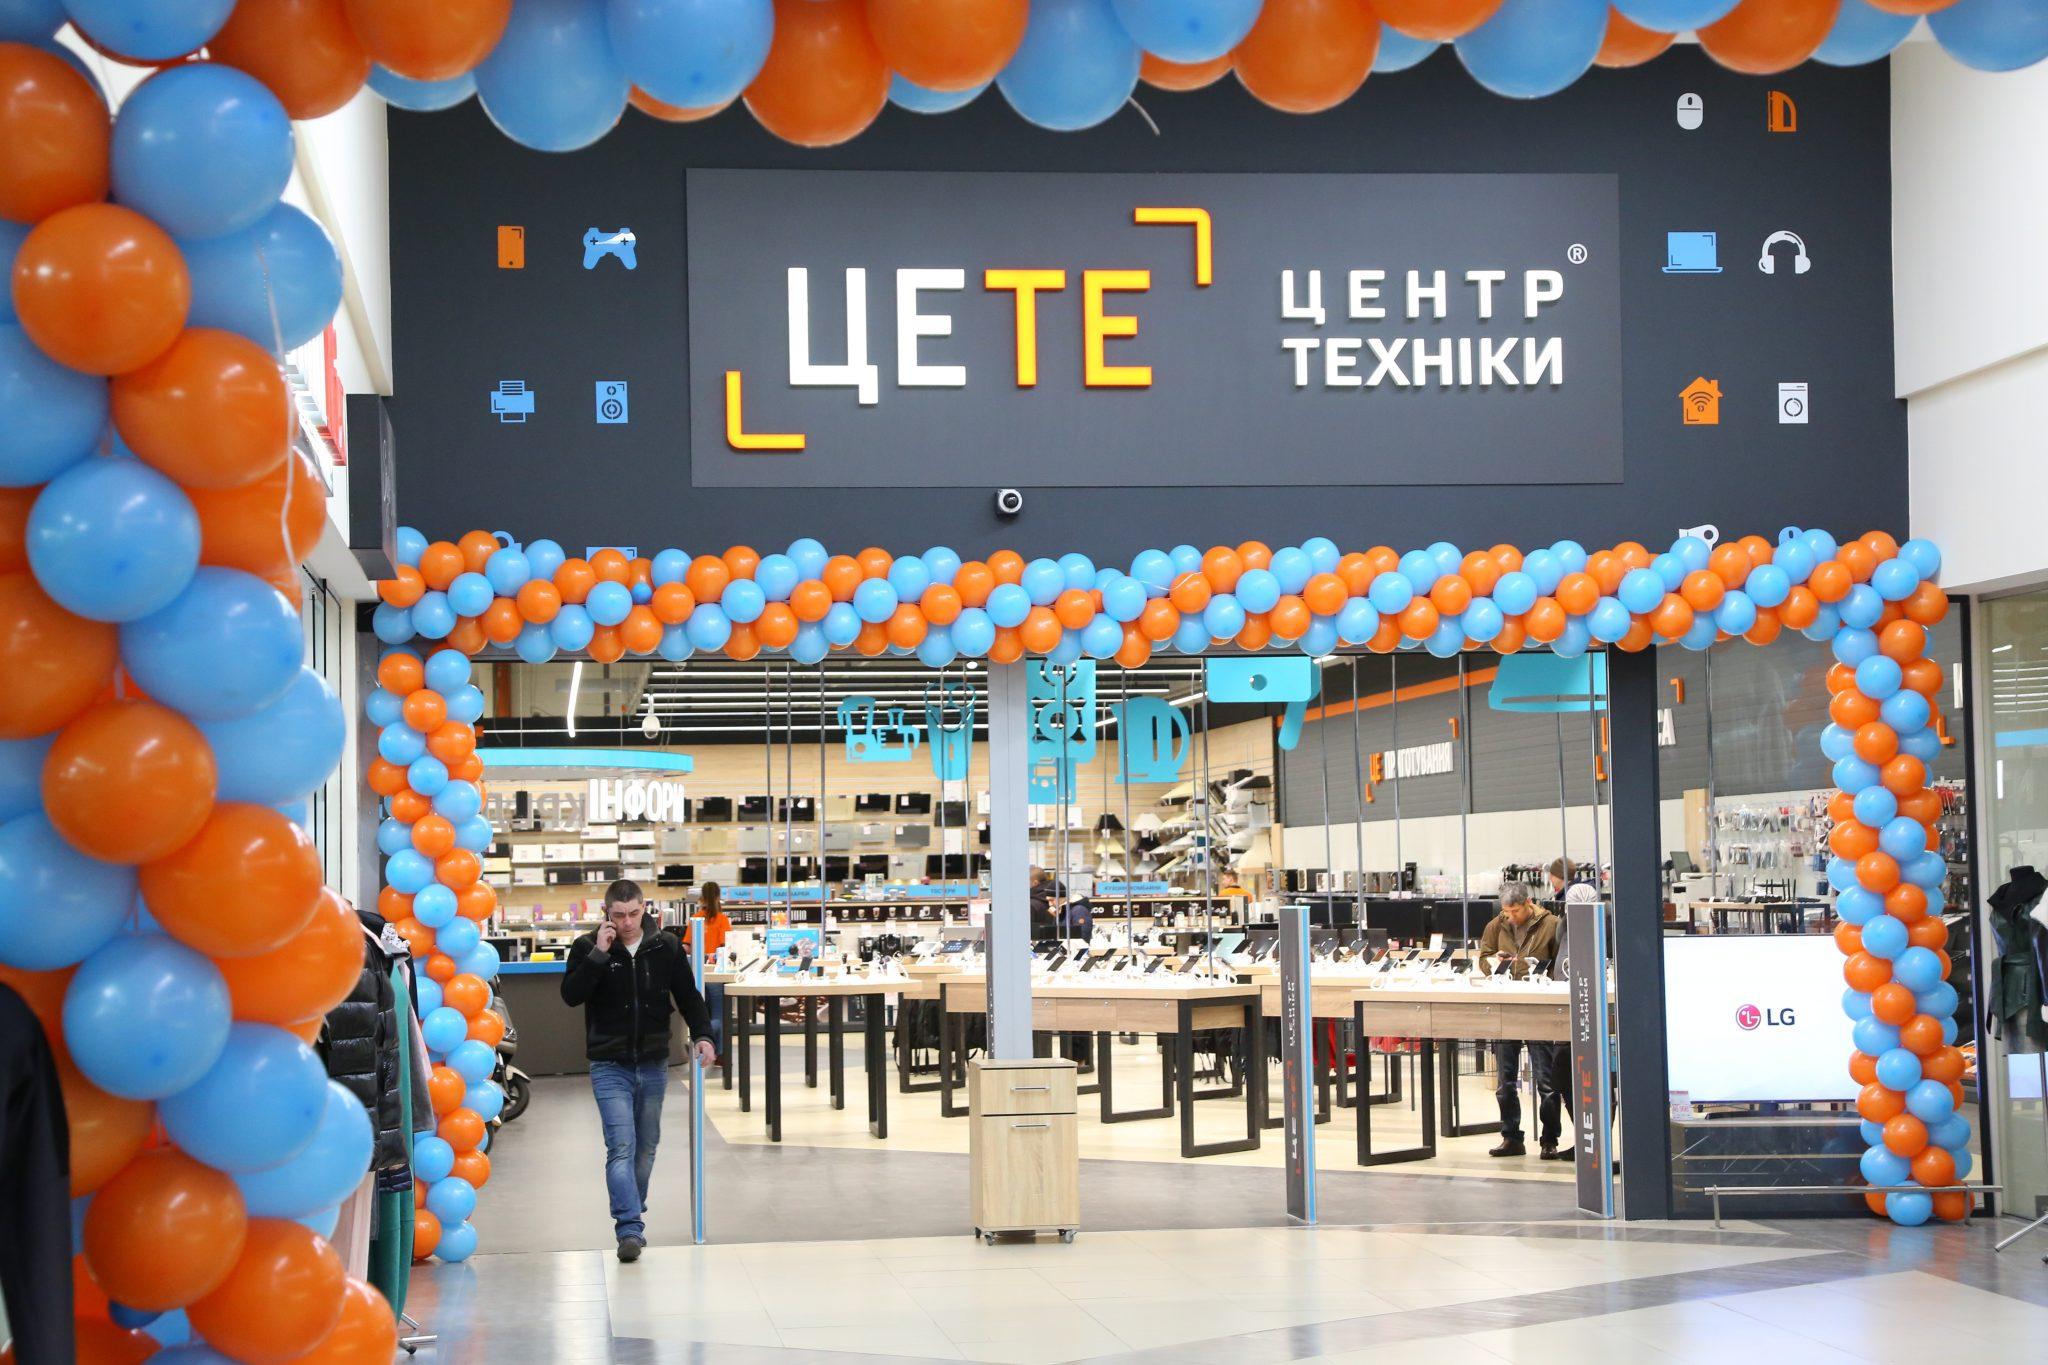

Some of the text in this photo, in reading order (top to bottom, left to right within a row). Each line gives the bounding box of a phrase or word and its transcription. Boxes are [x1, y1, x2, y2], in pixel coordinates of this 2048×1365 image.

[1281, 270, 1564, 325] ЦЕНТР
[788, 267, 1152, 404] ЦЕТЕ
[1281, 337, 1564, 386] ТЕХНІКИ
[1767, 1008, 1795, 1026] LG
